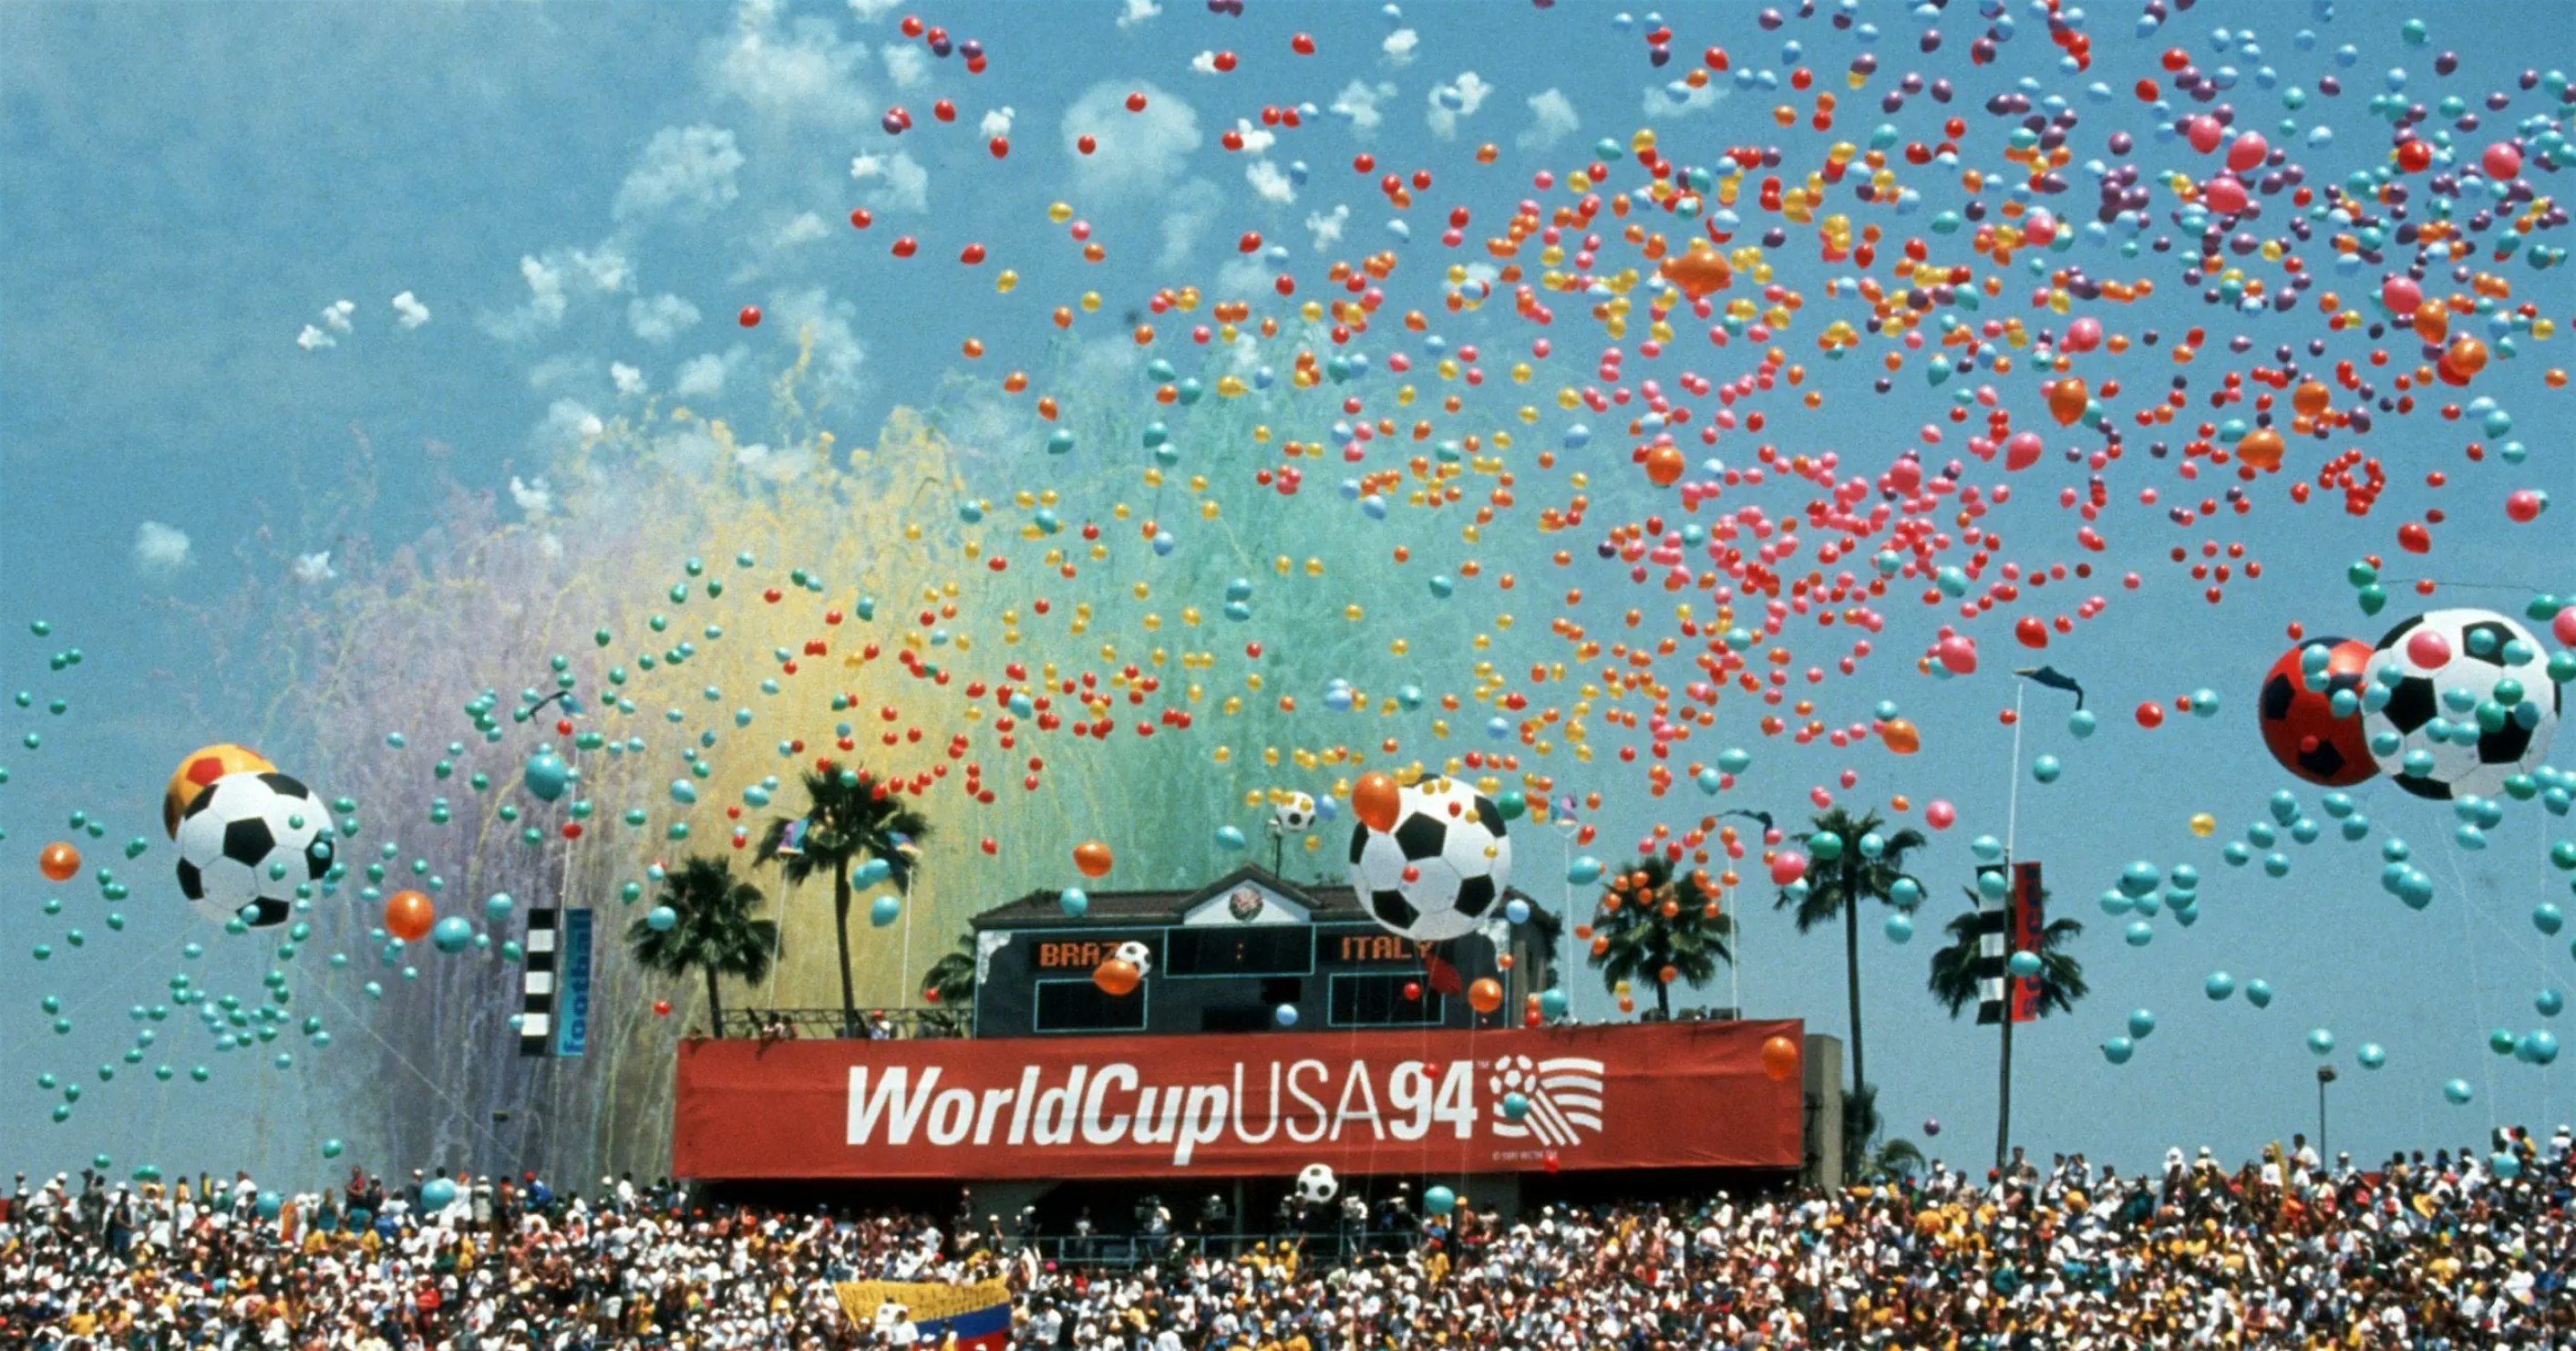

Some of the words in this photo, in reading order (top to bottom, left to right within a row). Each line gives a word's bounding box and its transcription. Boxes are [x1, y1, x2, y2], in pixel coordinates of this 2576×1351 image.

[1040, 942, 1121, 966] BRAZ
[1342, 936, 1434, 960] ITALY
[562, 910, 592, 1053] football
